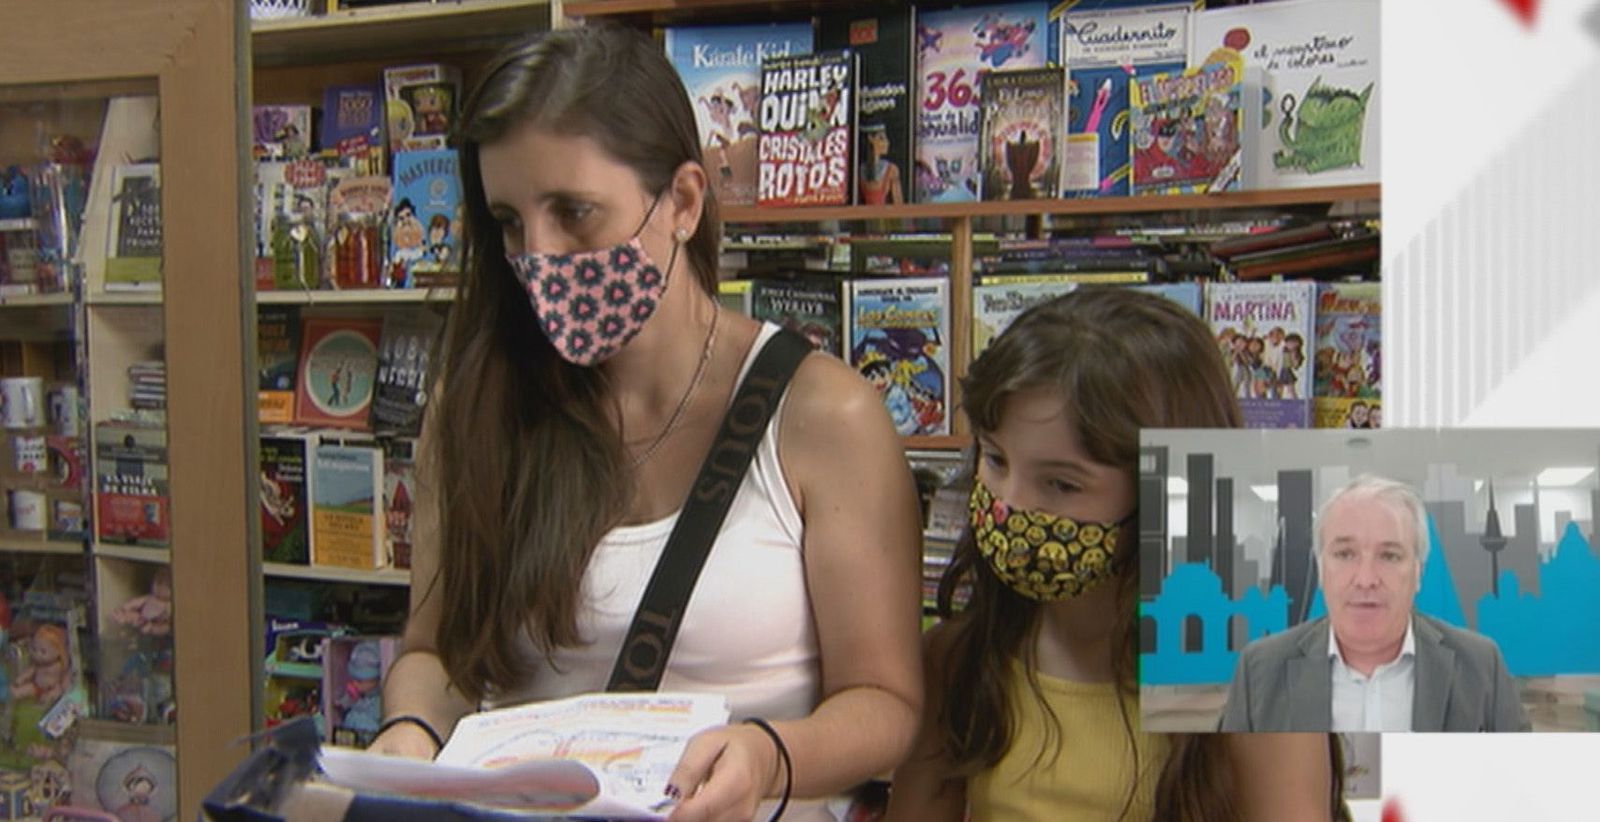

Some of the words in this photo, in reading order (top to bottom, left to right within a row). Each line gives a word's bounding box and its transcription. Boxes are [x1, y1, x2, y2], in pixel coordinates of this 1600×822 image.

[1079, 20, 1177, 45] Cuadernito
[764, 64, 848, 95] HARLEY
[761, 88, 849, 131] QUINN
[759, 128, 847, 163] CRISTALES
[759, 157, 846, 200] ROTOS
[1214, 299, 1296, 321] MARTINA
[697, 375, 779, 501] TOUS
[617, 609, 673, 692] TO
